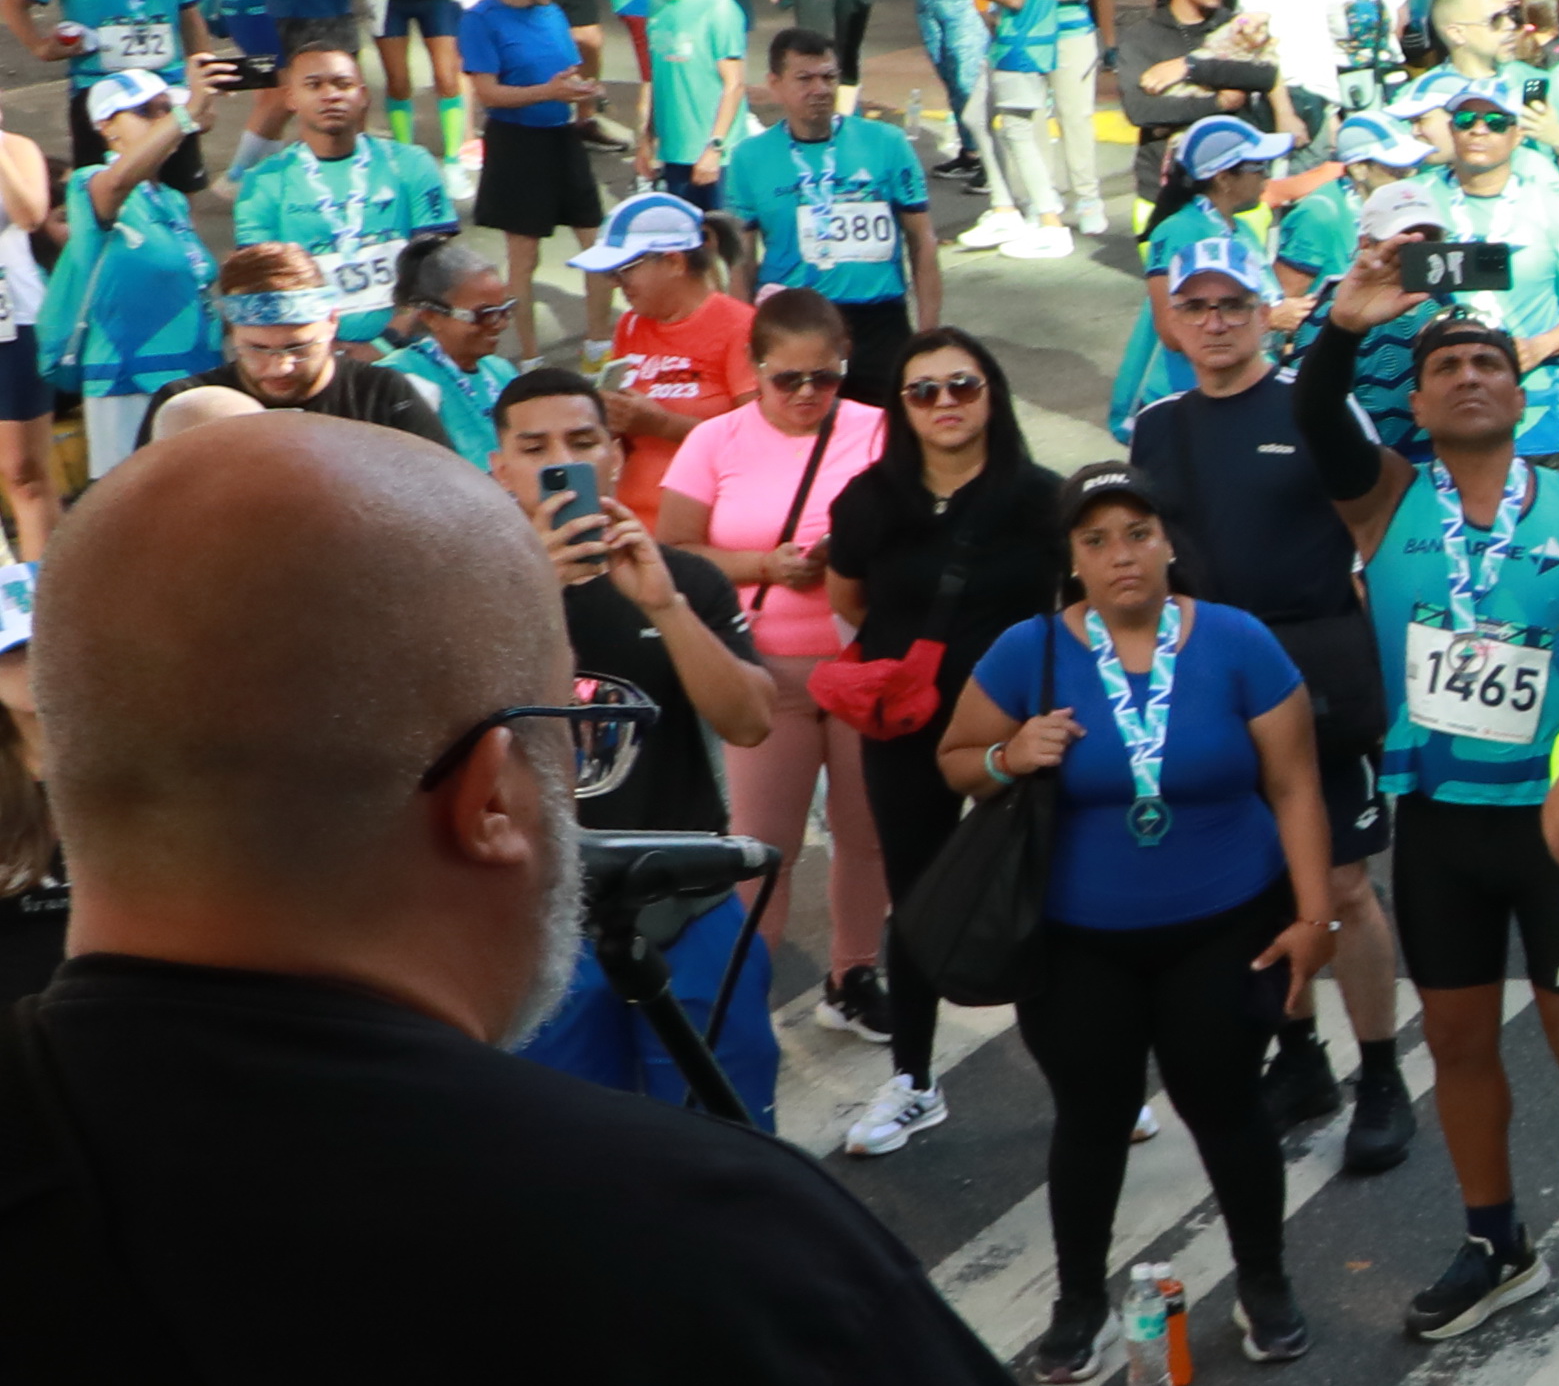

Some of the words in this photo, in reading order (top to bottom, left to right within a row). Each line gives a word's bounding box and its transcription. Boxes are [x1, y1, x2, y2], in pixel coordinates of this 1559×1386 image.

[649, 382, 700, 398] 2023
[1257, 443, 1296, 454] adidas
[1426, 650, 1541, 712] 1465
